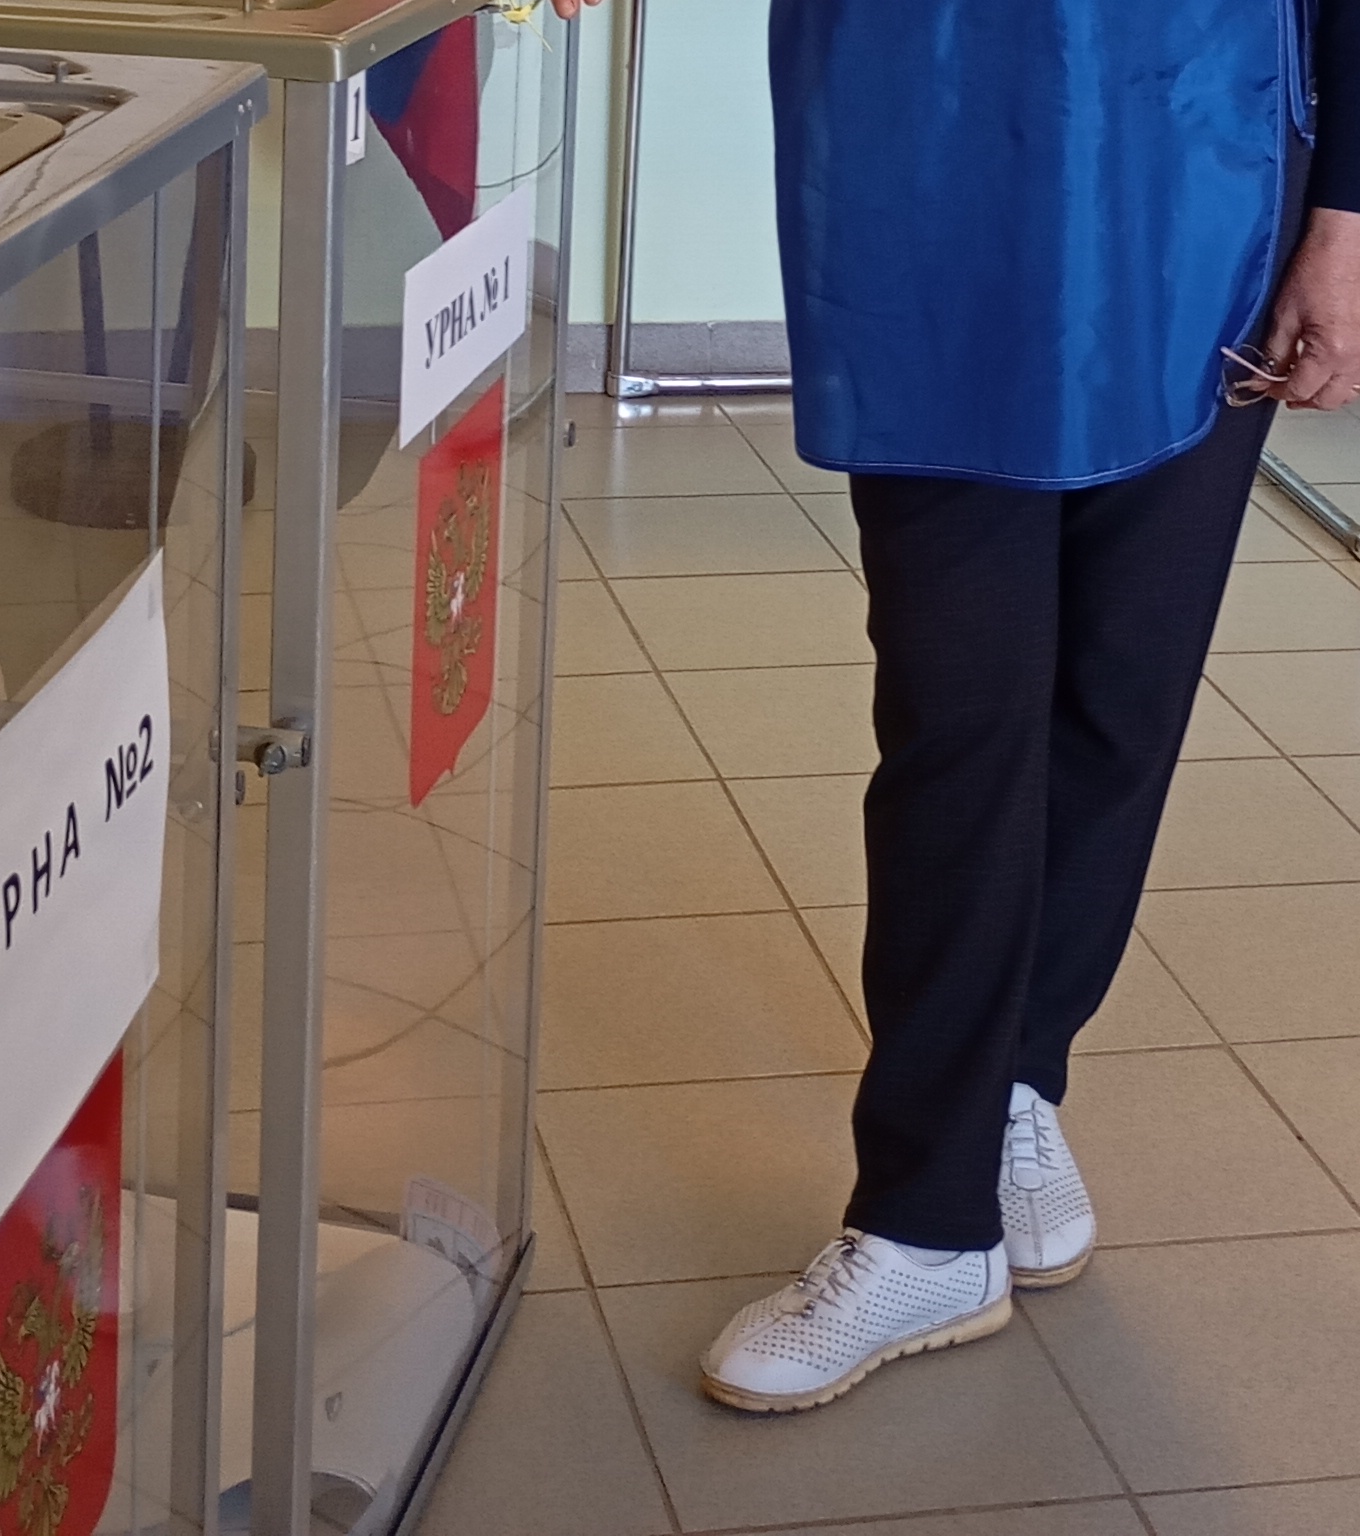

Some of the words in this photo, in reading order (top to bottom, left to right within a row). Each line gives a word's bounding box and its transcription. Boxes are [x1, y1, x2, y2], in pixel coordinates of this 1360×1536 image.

[349, 86, 361, 142] 1
[424, 284, 477, 370] УРНА
[480, 266, 499, 322] №
[503, 254, 510, 302] 1
[104, 713, 155, 824] №2
